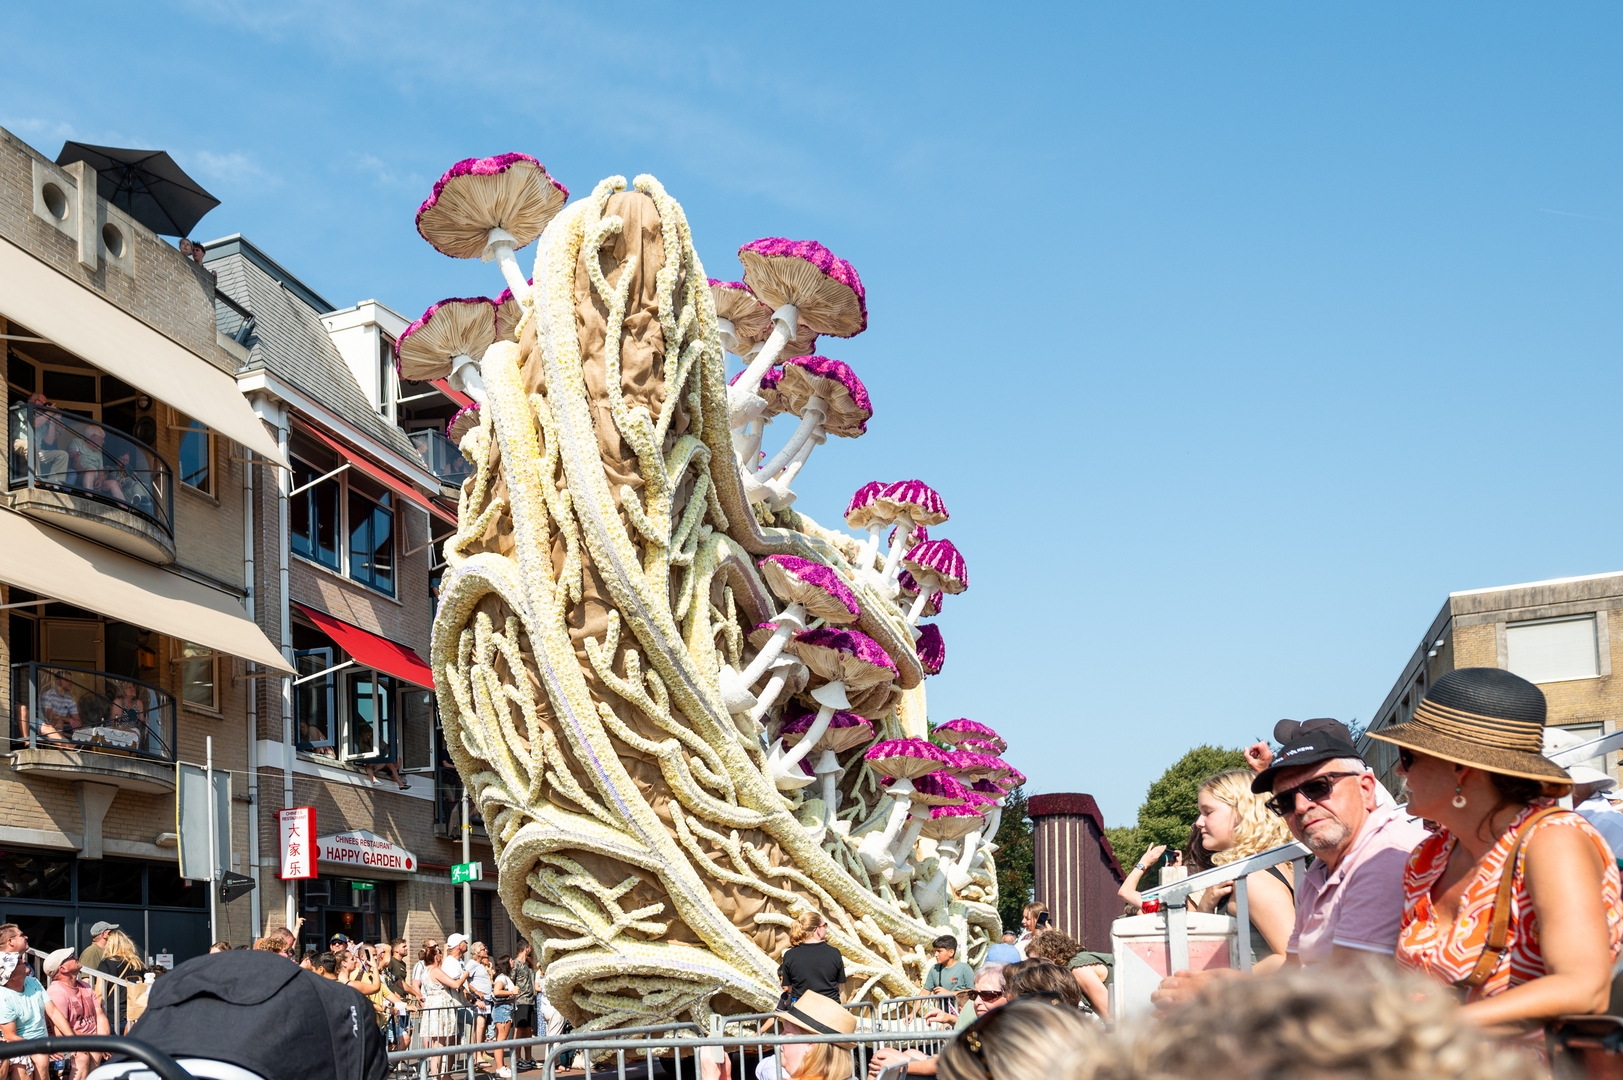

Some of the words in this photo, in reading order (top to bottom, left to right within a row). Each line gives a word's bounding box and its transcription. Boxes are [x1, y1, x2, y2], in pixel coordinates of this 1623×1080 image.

[288, 823, 301, 875] 大家乐
[335, 835, 359, 846] CHINEES
[360, 839, 392, 850] RESTAURANT
[326, 846, 360, 863] HAPPY
[362, 851, 401, 868] GARDEN
